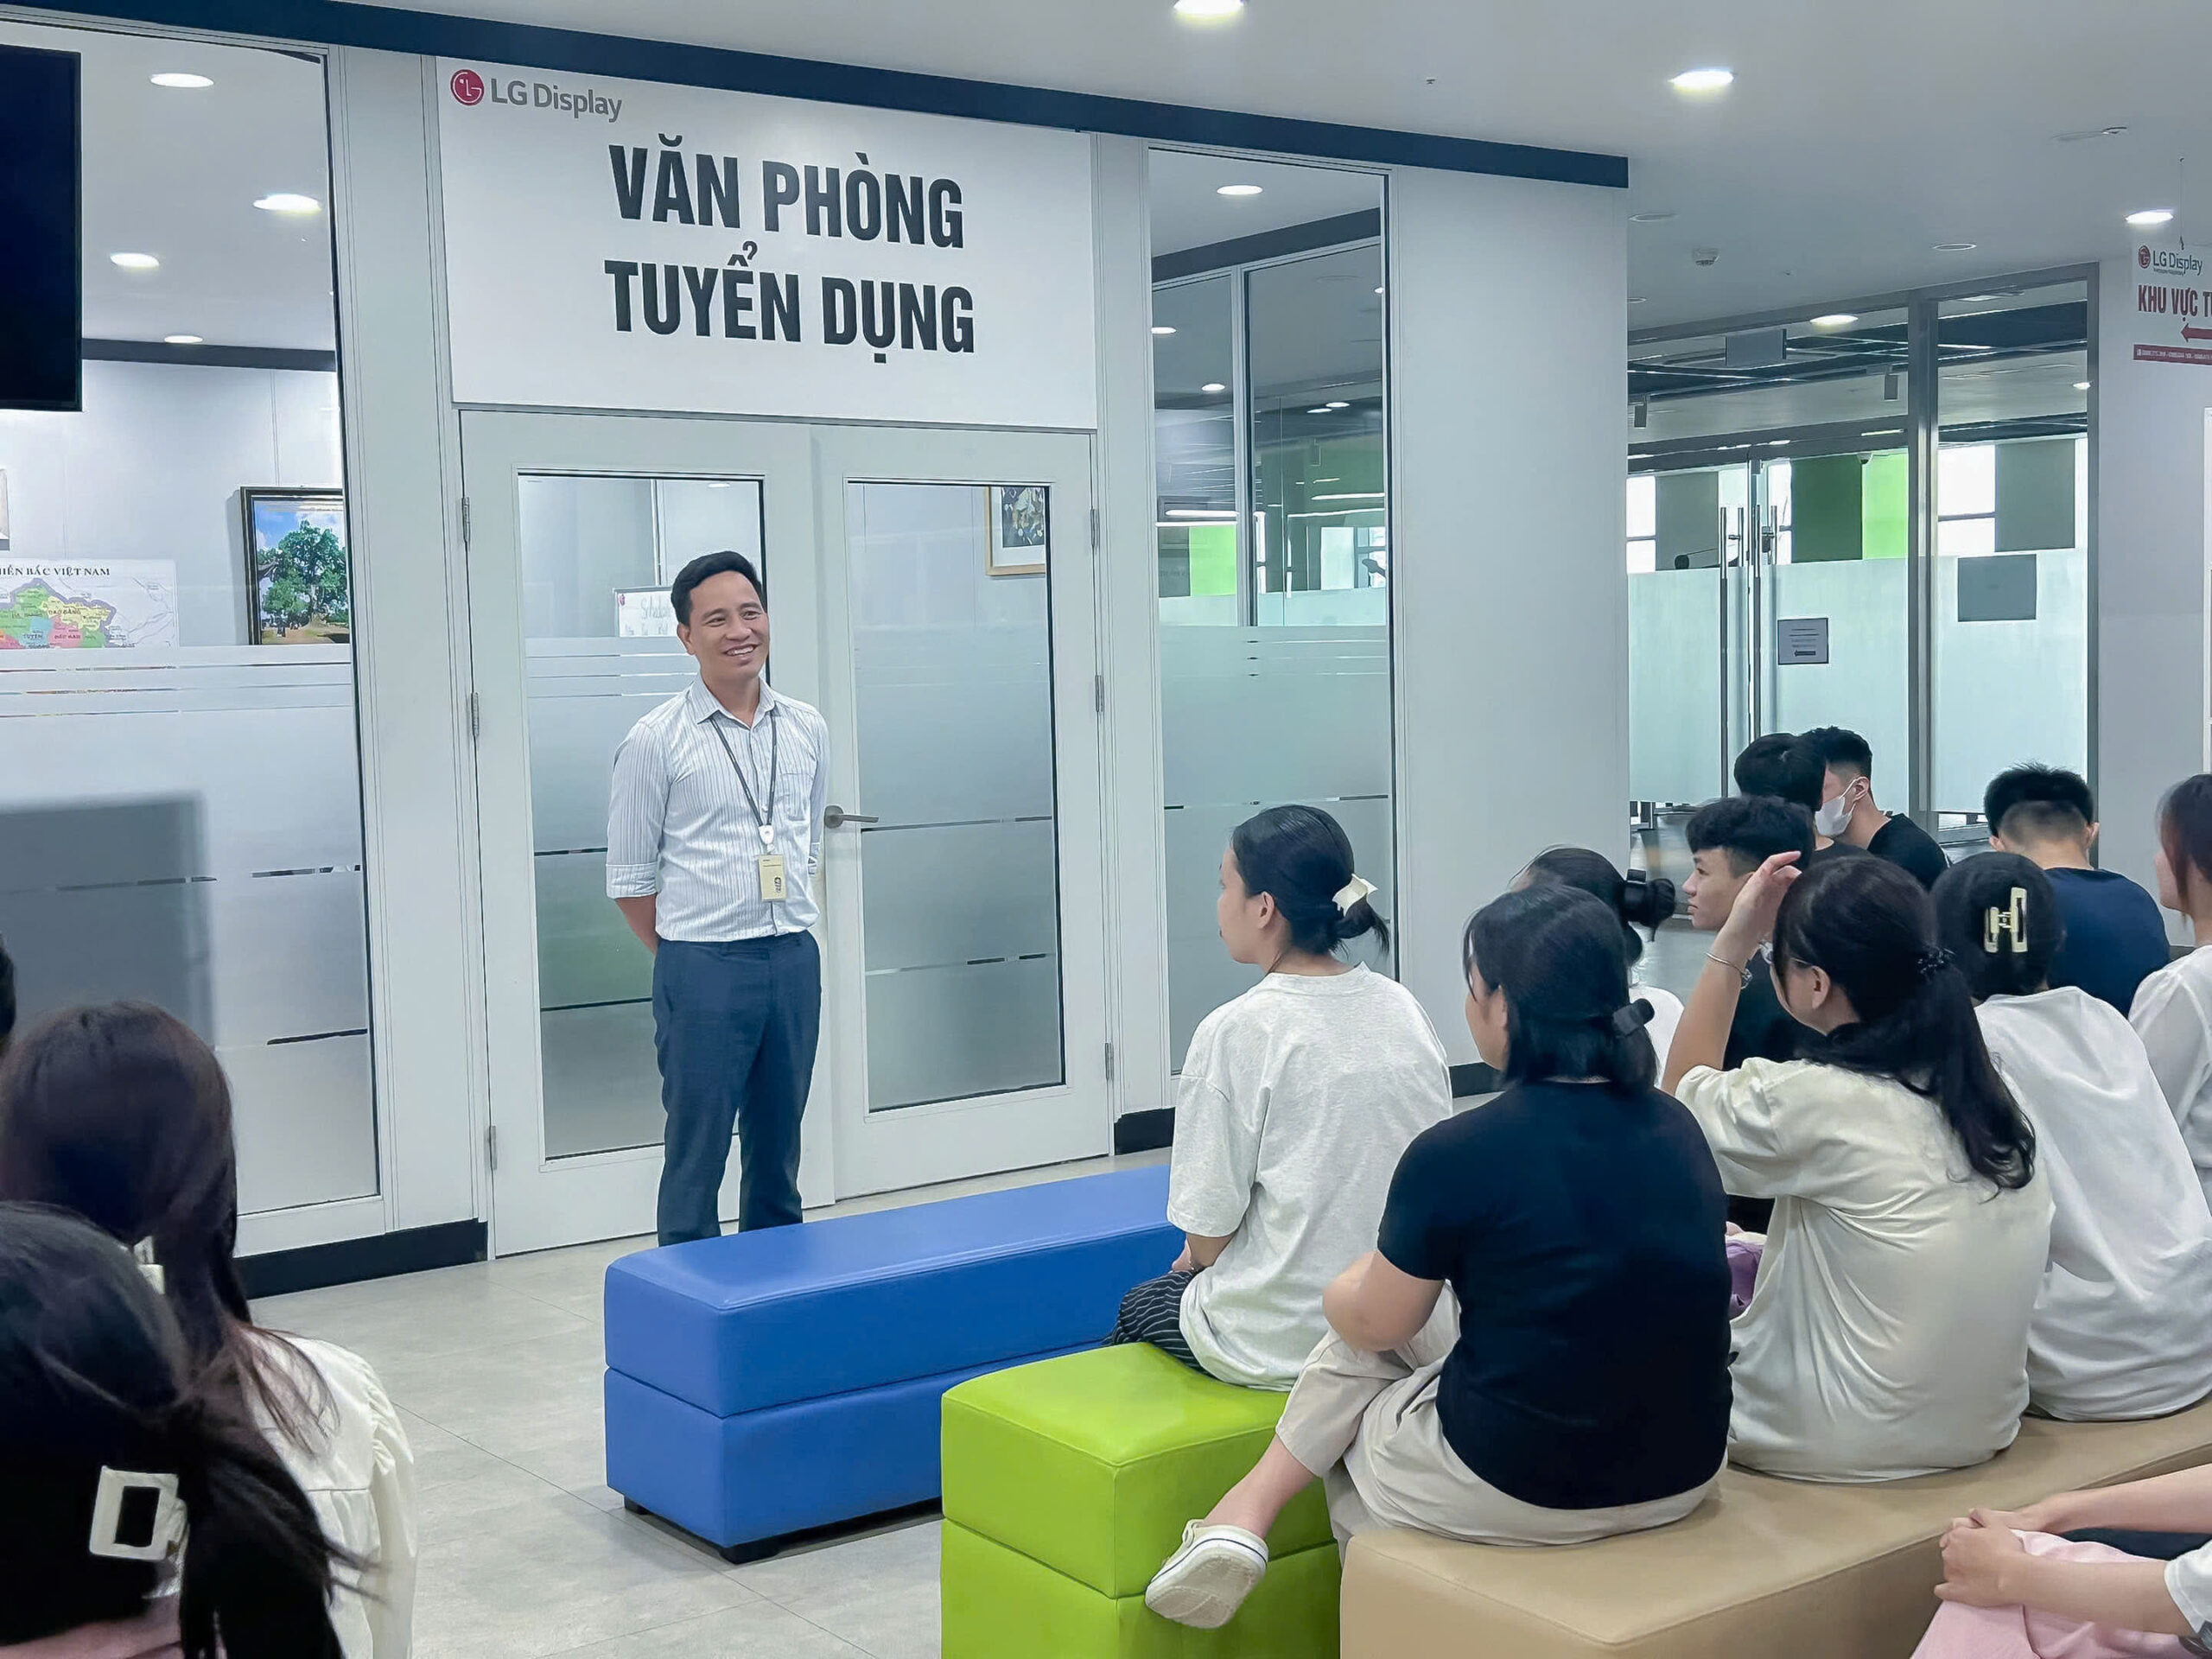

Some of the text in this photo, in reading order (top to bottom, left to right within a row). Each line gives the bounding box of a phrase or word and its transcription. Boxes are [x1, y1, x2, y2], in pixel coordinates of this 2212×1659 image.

[491, 78, 622, 123] LG Display
[609, 132, 964, 248] VĂN PHÒNG
[2152, 250, 2202, 276] LG Display
[605, 240, 974, 364] TUYỂN DỤNG
[2138, 284, 2167, 314] KHU
[2171, 287, 2198, 322] VỰC
